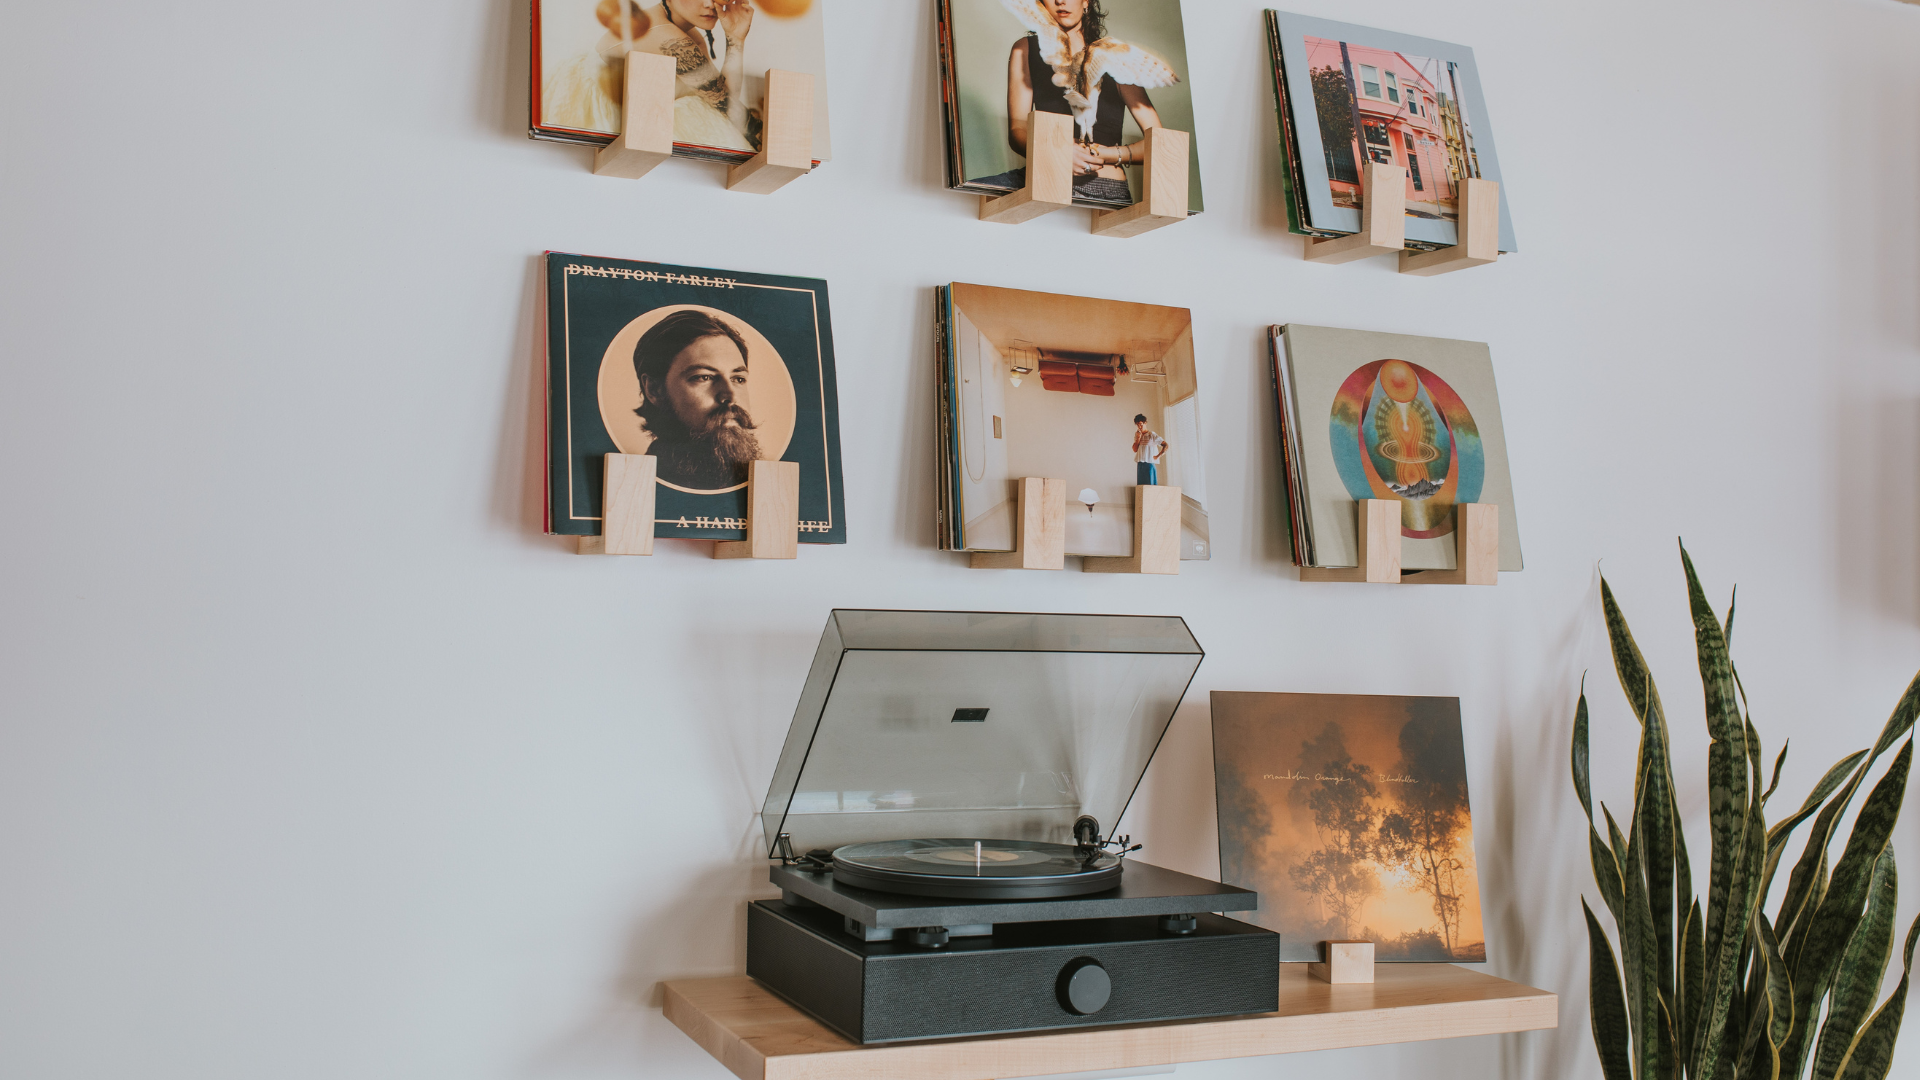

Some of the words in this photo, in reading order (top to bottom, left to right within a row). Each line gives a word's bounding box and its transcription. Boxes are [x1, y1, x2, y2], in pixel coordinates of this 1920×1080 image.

[568, 263, 659, 282] DRAYTON
[665, 272, 737, 289] FARLEY
[676, 515, 690, 528] A
[798, 520, 829, 533] IFE
[1263, 769, 1310, 781] Mandolin
